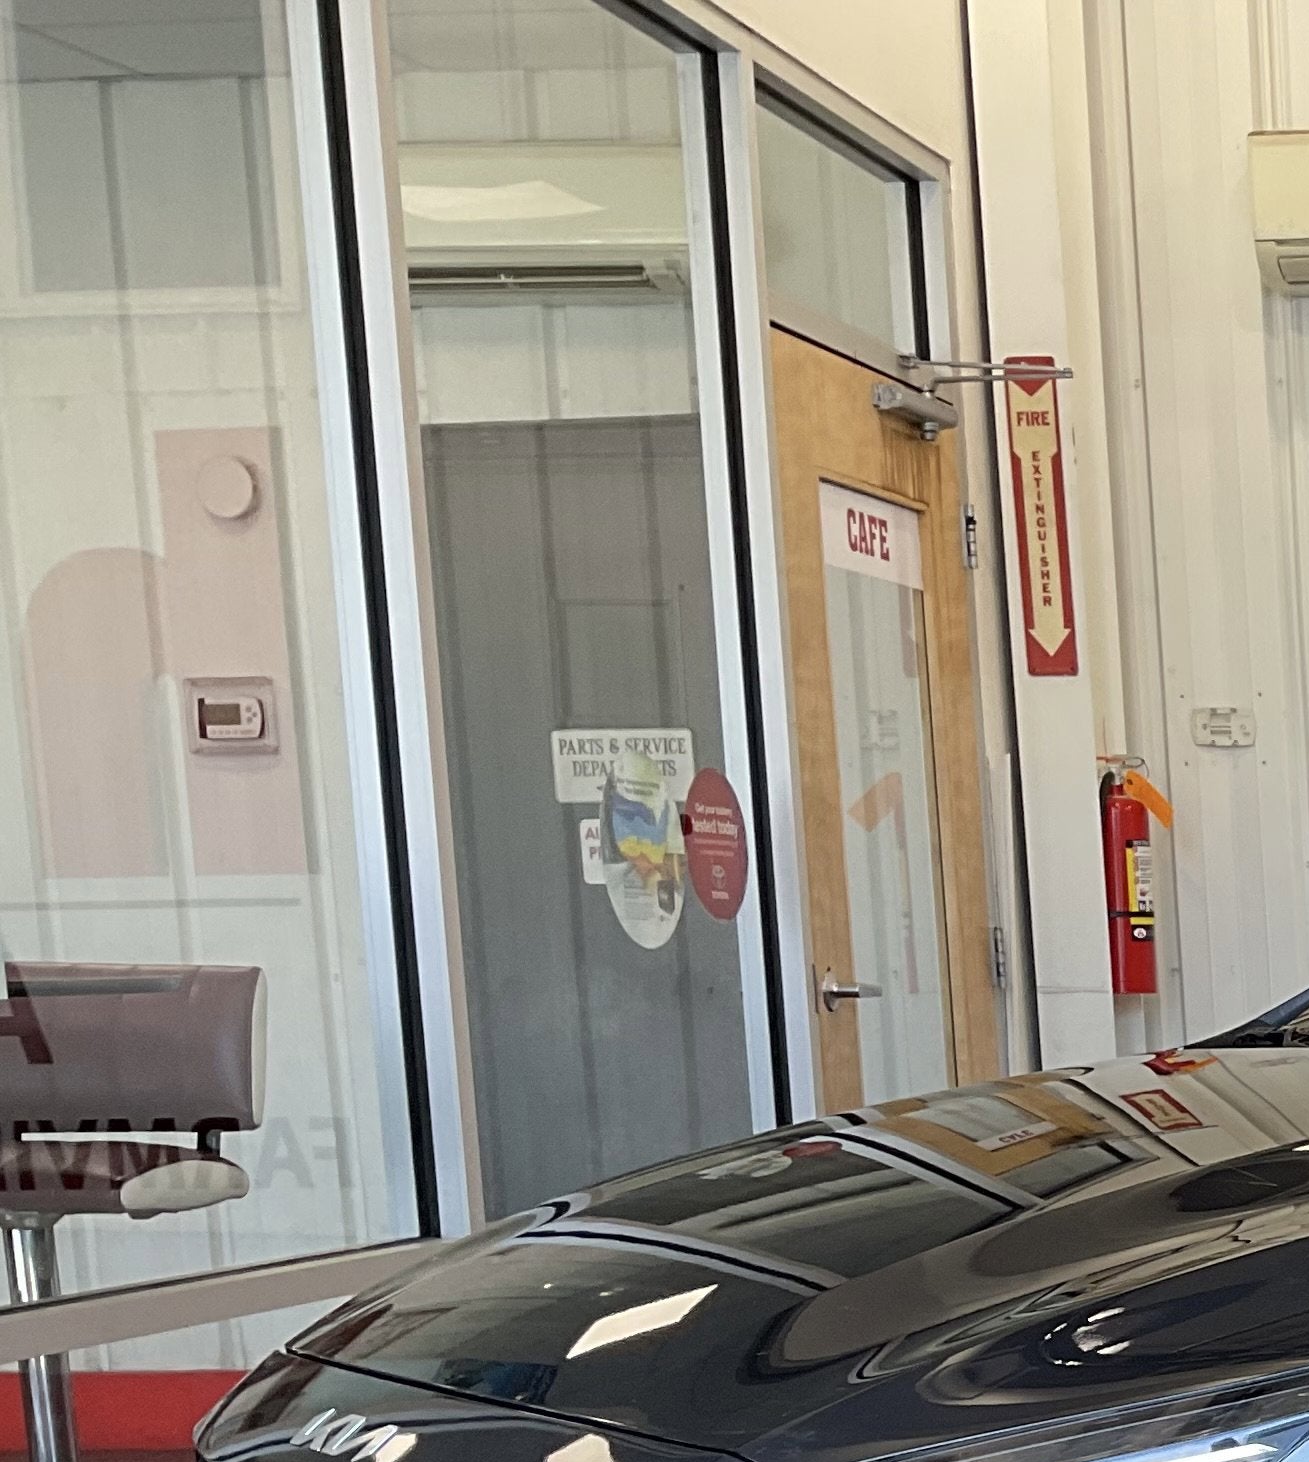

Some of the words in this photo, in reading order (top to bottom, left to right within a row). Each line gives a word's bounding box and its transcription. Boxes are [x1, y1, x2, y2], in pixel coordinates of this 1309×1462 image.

[1016, 411, 1050, 427] FIRE
[847, 508, 890, 562] CAFE
[1031, 451, 1052, 606] EXTINGUISHER
[558, 738, 604, 755] PARTS
[609, 738, 619, 754] &
[624, 738, 687, 754] SERVICE
[572, 760, 678, 777] DEPATS
